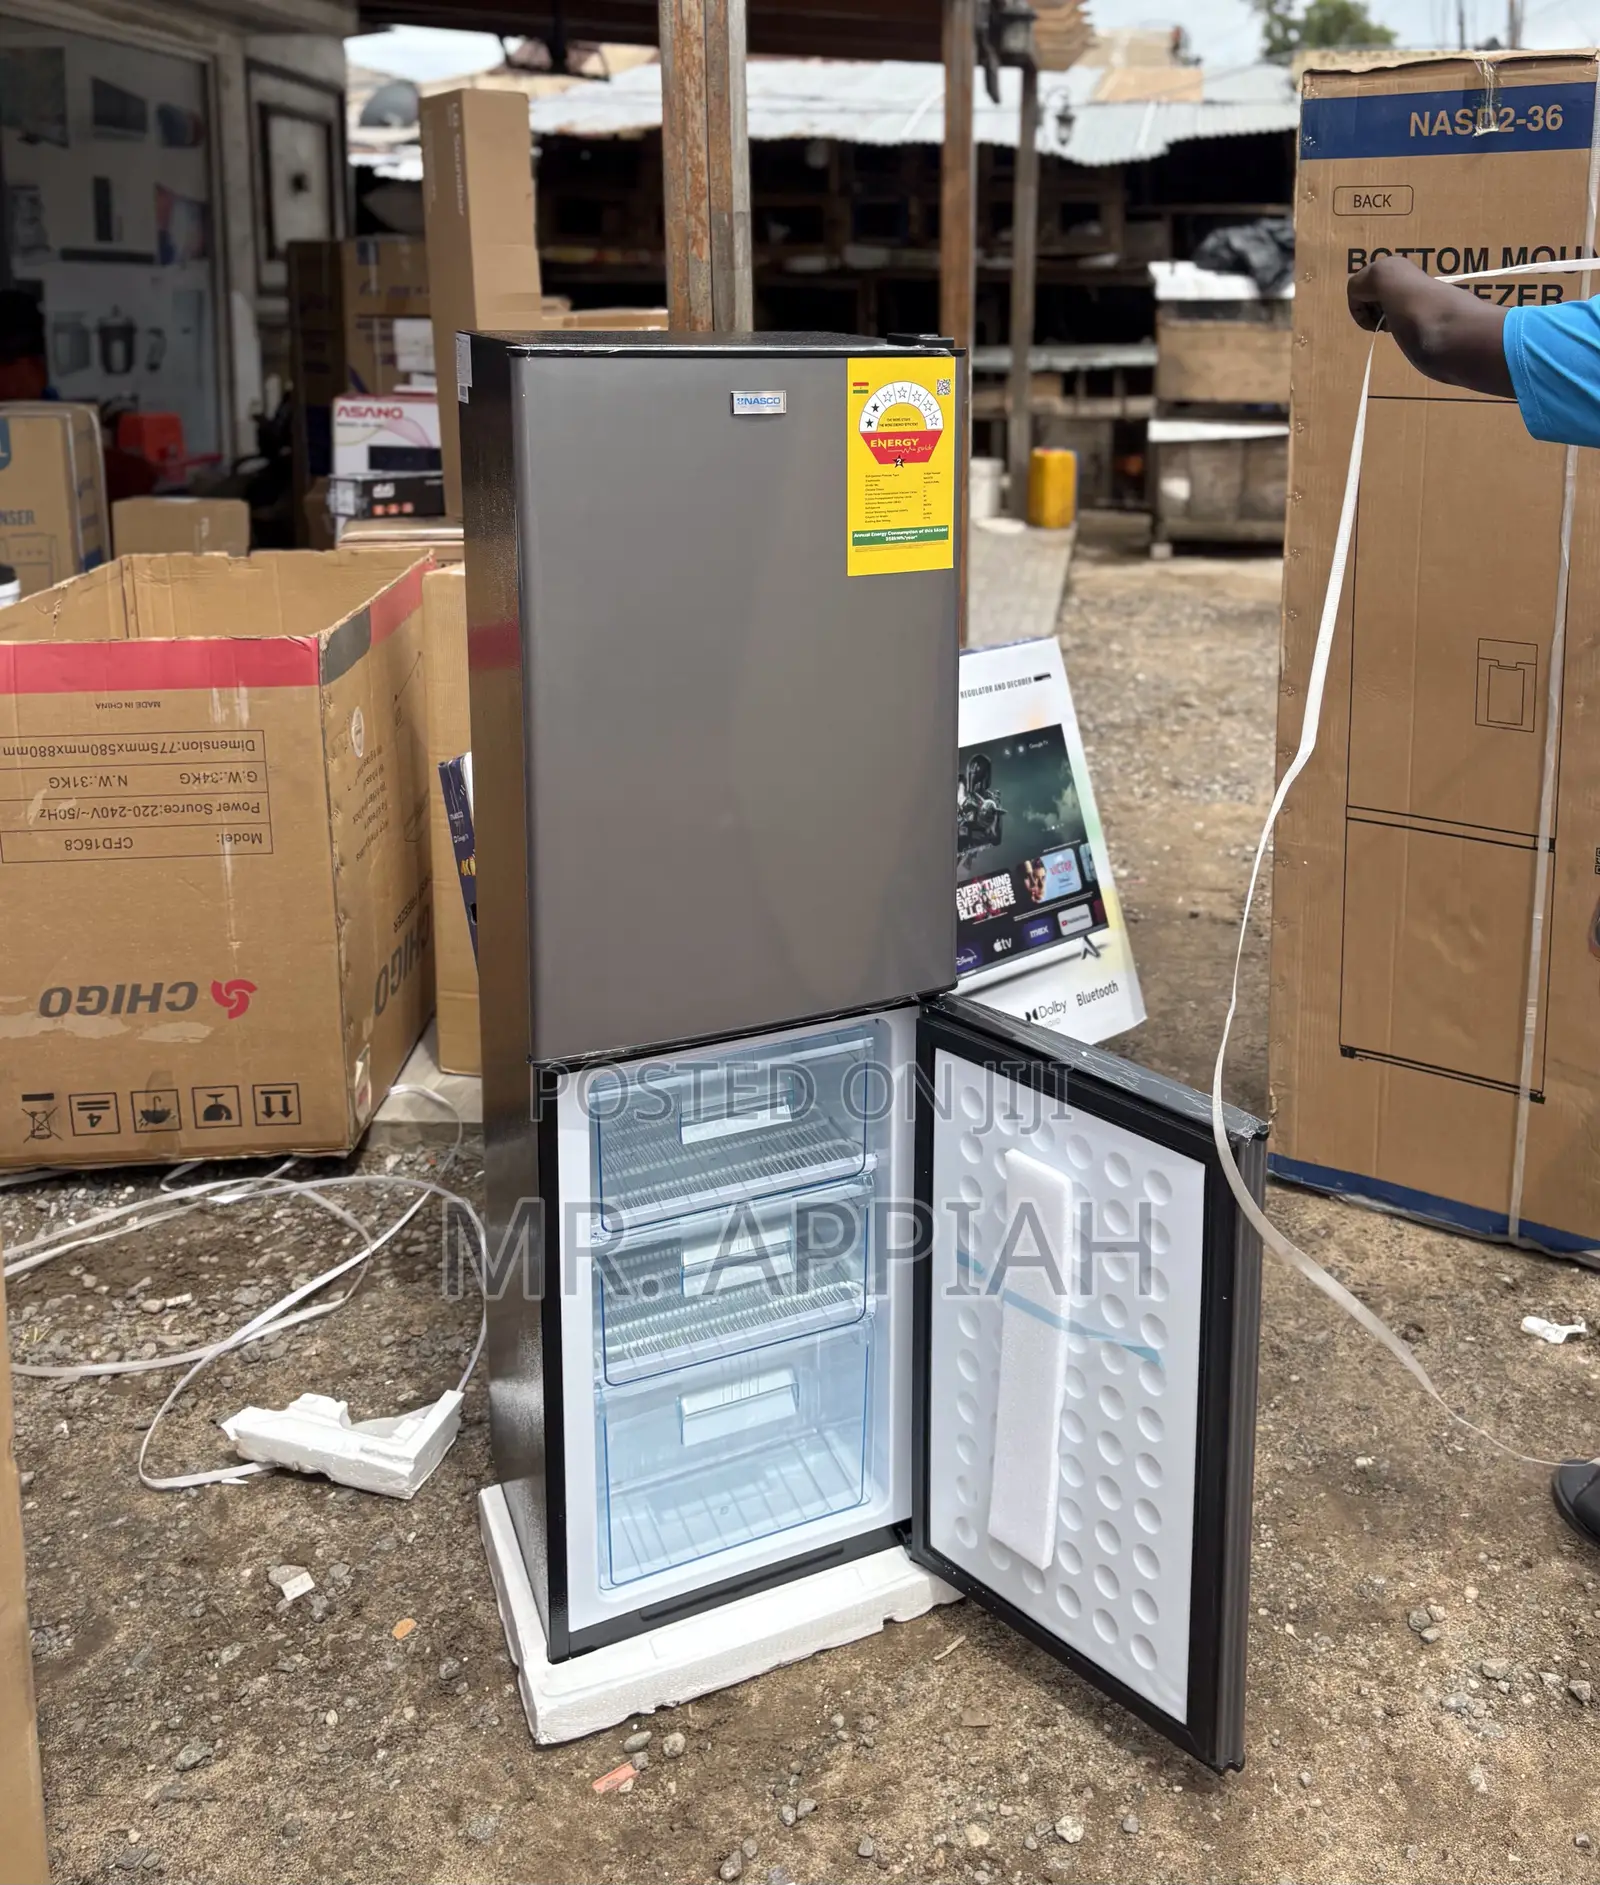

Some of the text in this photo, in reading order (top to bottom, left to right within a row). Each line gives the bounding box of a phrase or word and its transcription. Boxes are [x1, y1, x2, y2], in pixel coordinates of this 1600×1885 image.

[1409, 104, 1564, 137] NASD2-36
[1352, 194, 1393, 208] BACK
[1501, 245, 1600, 275] MOU
[744, 397, 781, 405] NASCO
[337, 406, 403, 420] ASANO
[870, 438, 920, 449] ENERGY
[960, 676, 1033, 699] REGULATOR AND DECODER
[136, 701, 161, 709] MADE
[3, 739, 256, 757] Dimension:775mmx580mmx880mm
[216, 801, 261, 814] Power
[64, 832, 263, 851] Model: CFD16C8
[375, 904, 430, 1017] CHIGO
[38, 981, 199, 1018] CHIGO
[1075, 980, 1119, 1007] Bluetooth
[1038, 1000, 1067, 1018] Dolby
